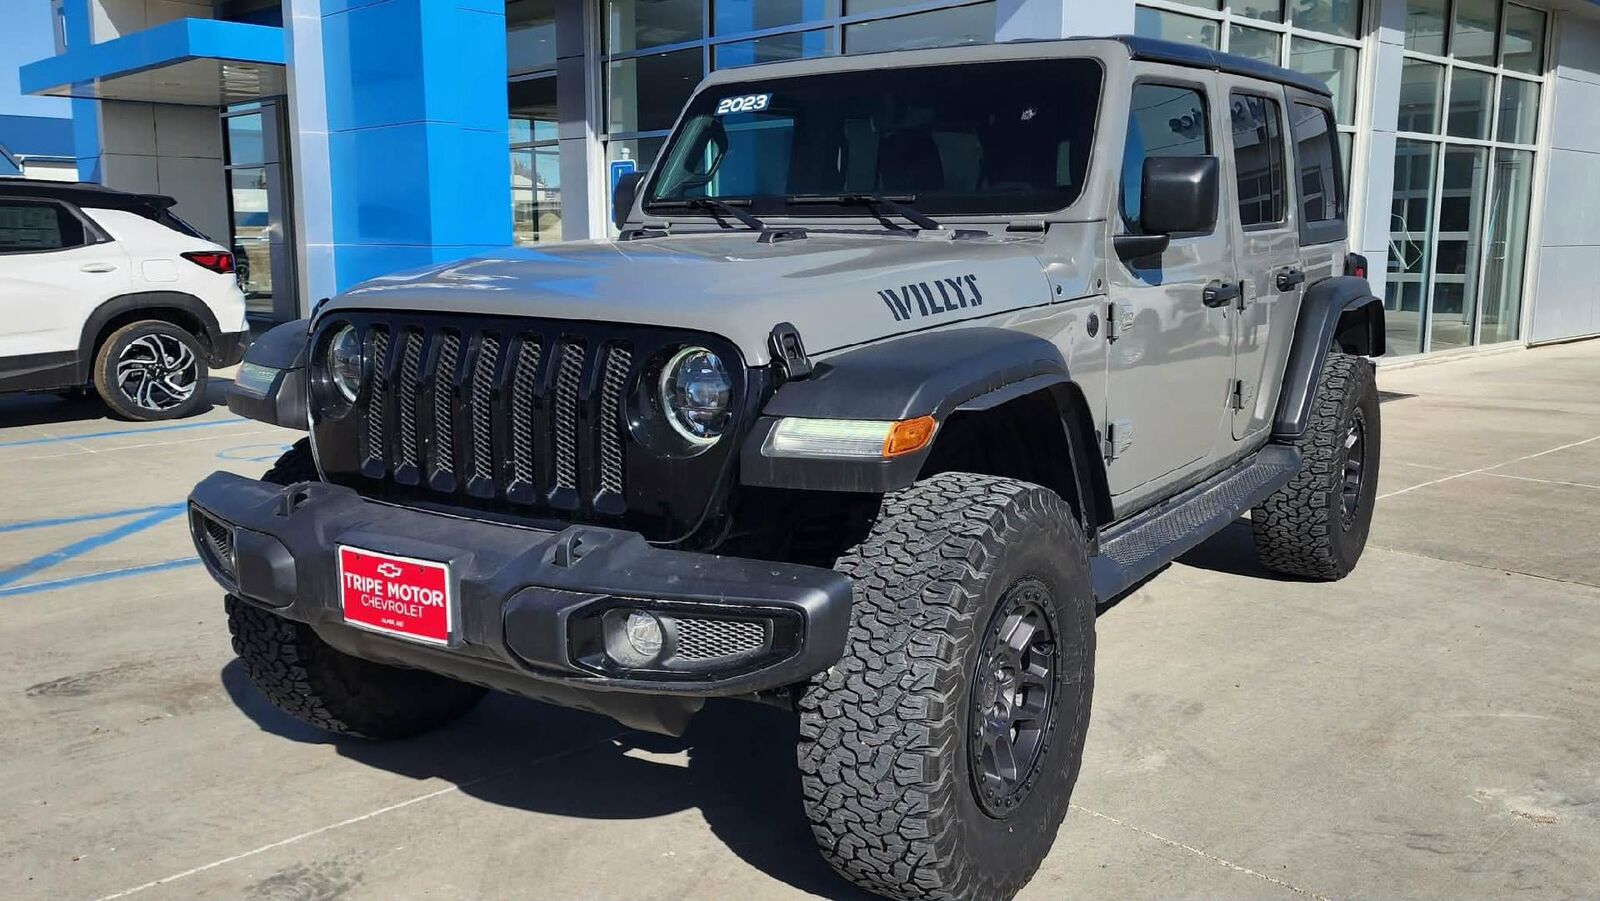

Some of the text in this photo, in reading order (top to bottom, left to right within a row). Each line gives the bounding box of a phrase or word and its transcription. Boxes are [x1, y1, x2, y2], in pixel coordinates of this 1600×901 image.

[717, 94, 768, 114] 2023
[877, 274, 982, 321] WILLYS
[344, 572, 444, 607] TRIPE MOTOR
[361, 594, 424, 618] CHEVROLET
